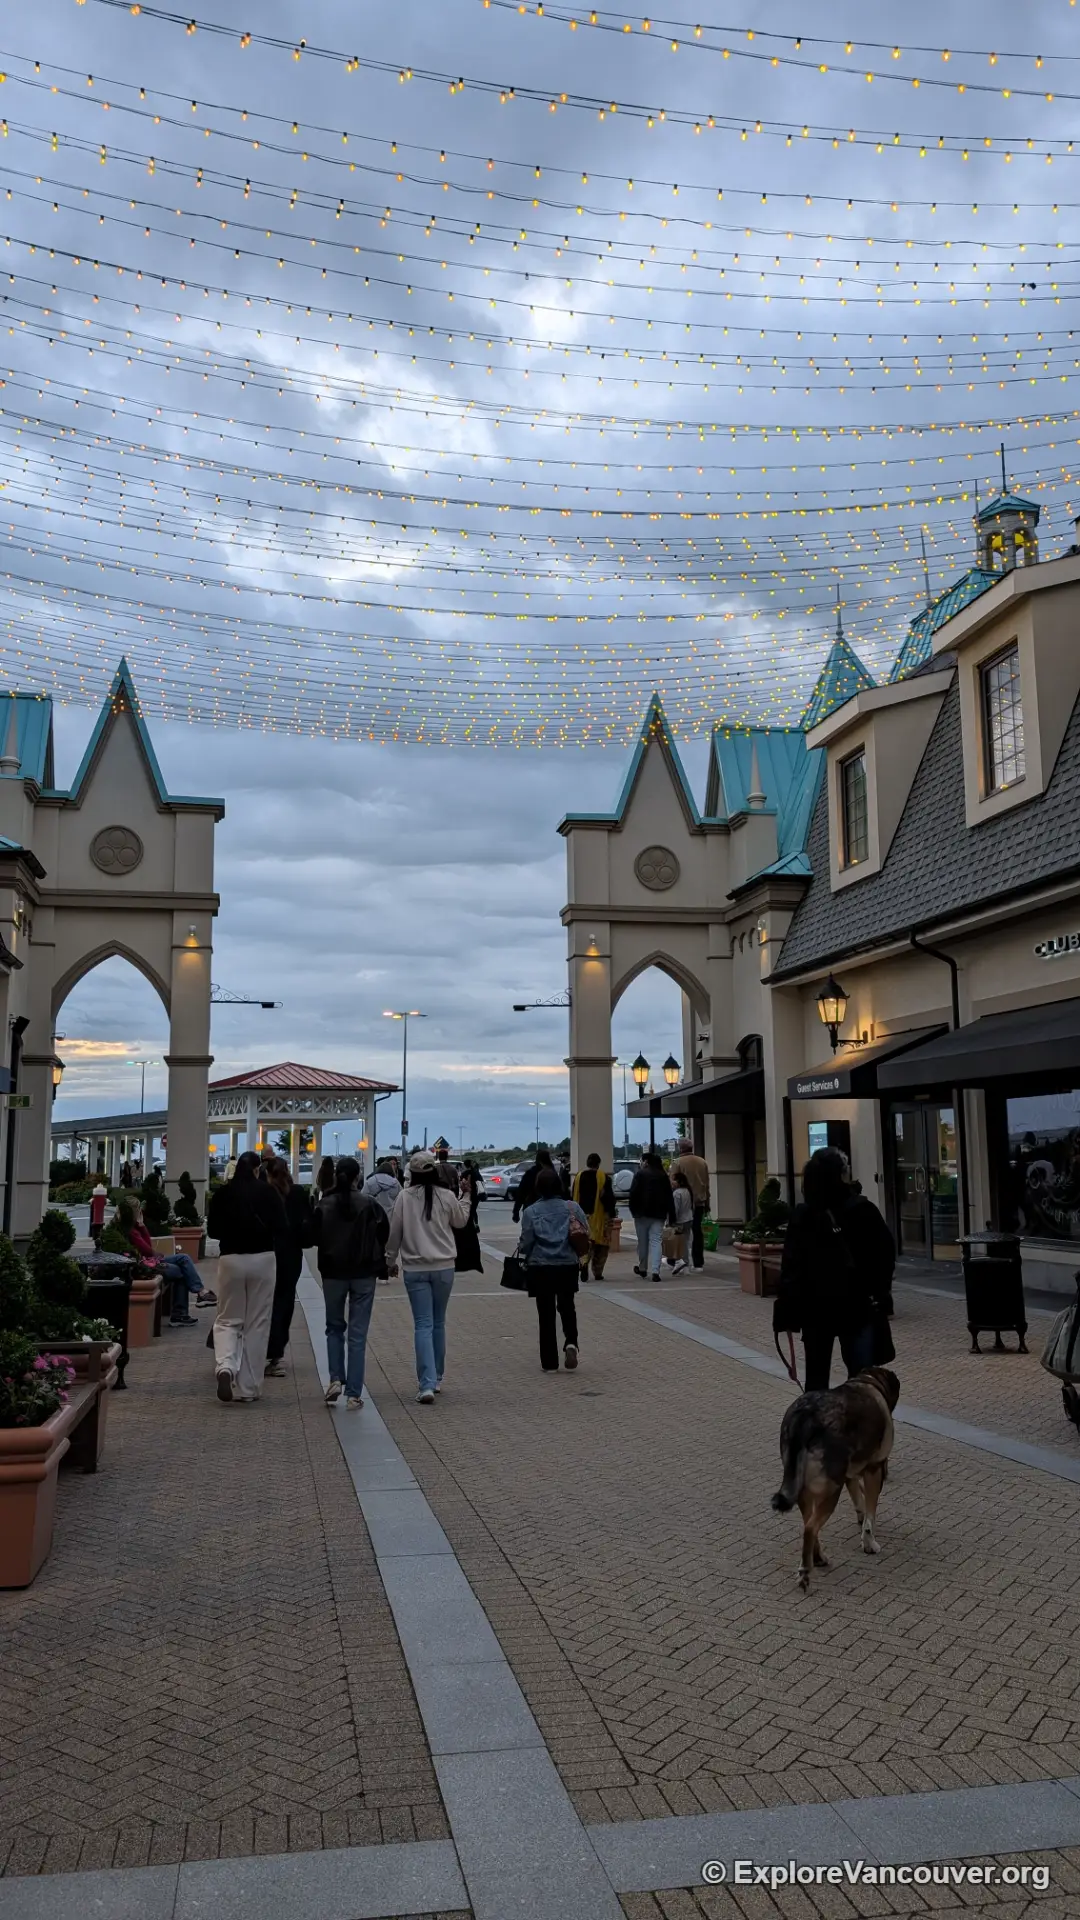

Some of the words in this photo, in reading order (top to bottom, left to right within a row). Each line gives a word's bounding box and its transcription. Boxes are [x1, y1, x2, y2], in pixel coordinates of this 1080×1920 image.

[1033, 934, 1080, 957] CLUB
[797, 1082, 812, 1093] Guest
[812, 1080, 833, 1091] Services
